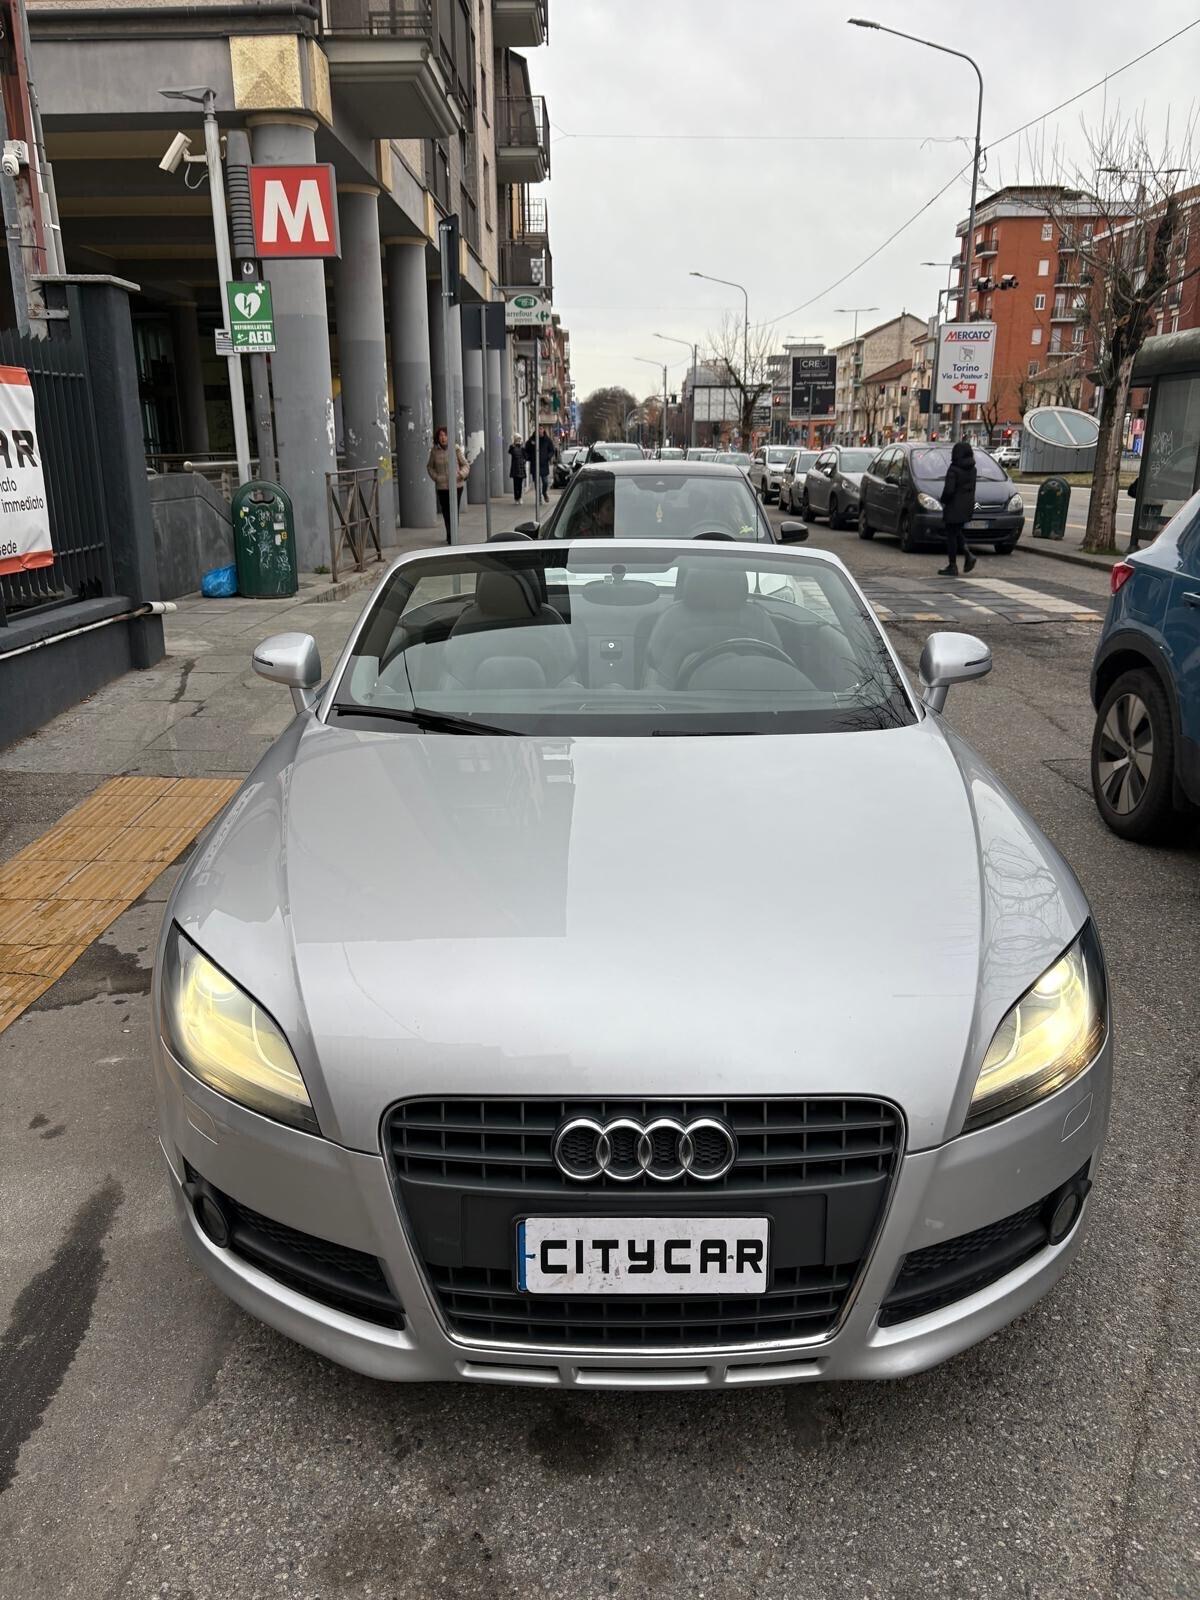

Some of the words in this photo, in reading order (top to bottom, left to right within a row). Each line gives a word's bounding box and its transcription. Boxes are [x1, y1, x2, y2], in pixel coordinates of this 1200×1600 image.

[262, 179, 330, 243] M
[248, 331, 273, 343] AED
[952, 363, 980, 372] Torino
[1, 495, 44, 513] immediato
[540, 1239, 763, 1274] CITYCAR
